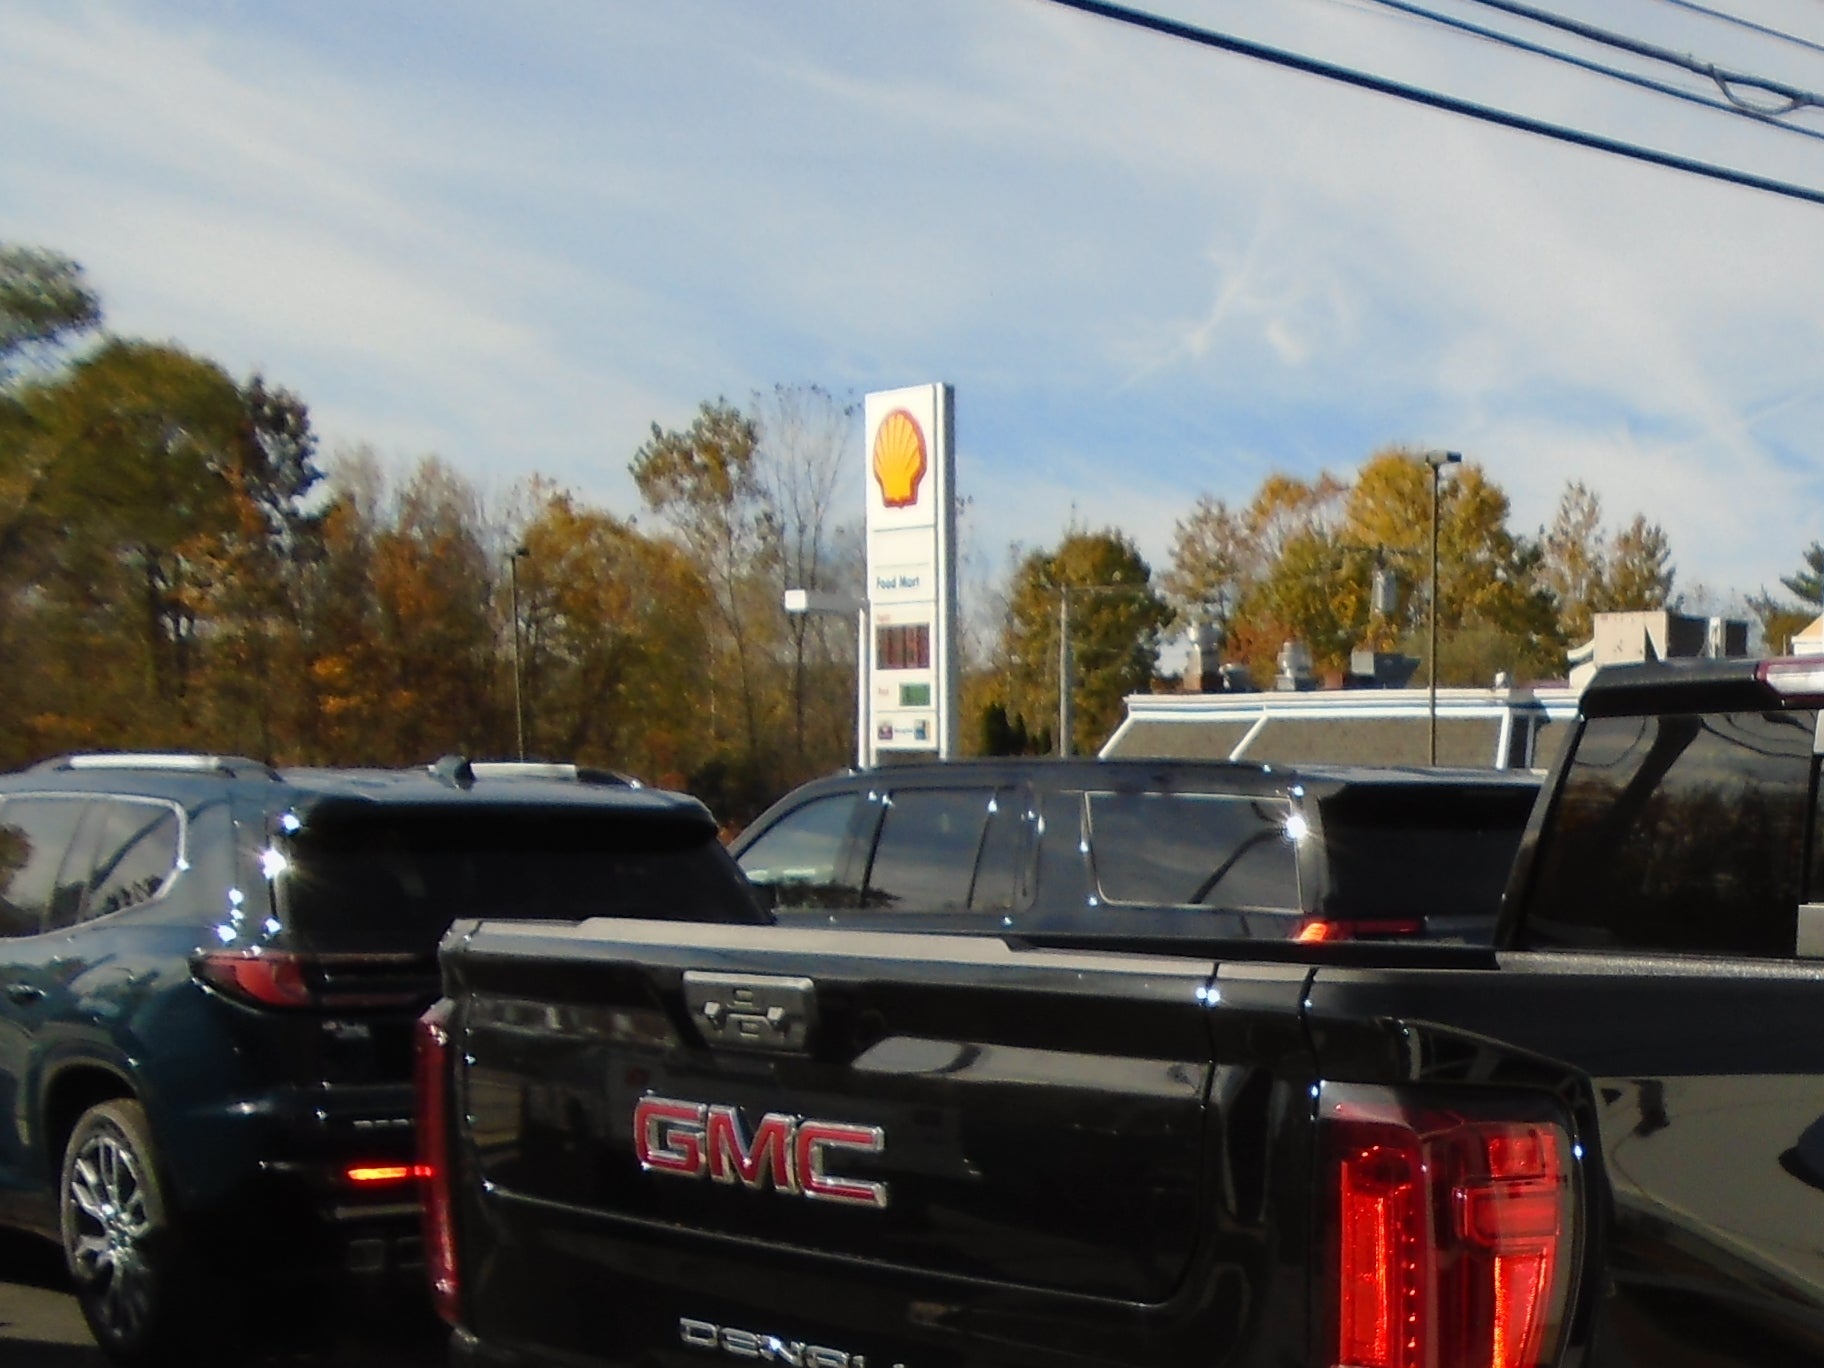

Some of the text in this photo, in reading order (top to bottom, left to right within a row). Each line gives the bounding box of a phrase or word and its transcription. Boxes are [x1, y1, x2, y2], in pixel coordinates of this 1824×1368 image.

[876, 575, 920, 590] Food Mart
[634, 1094, 887, 1209] GMC
